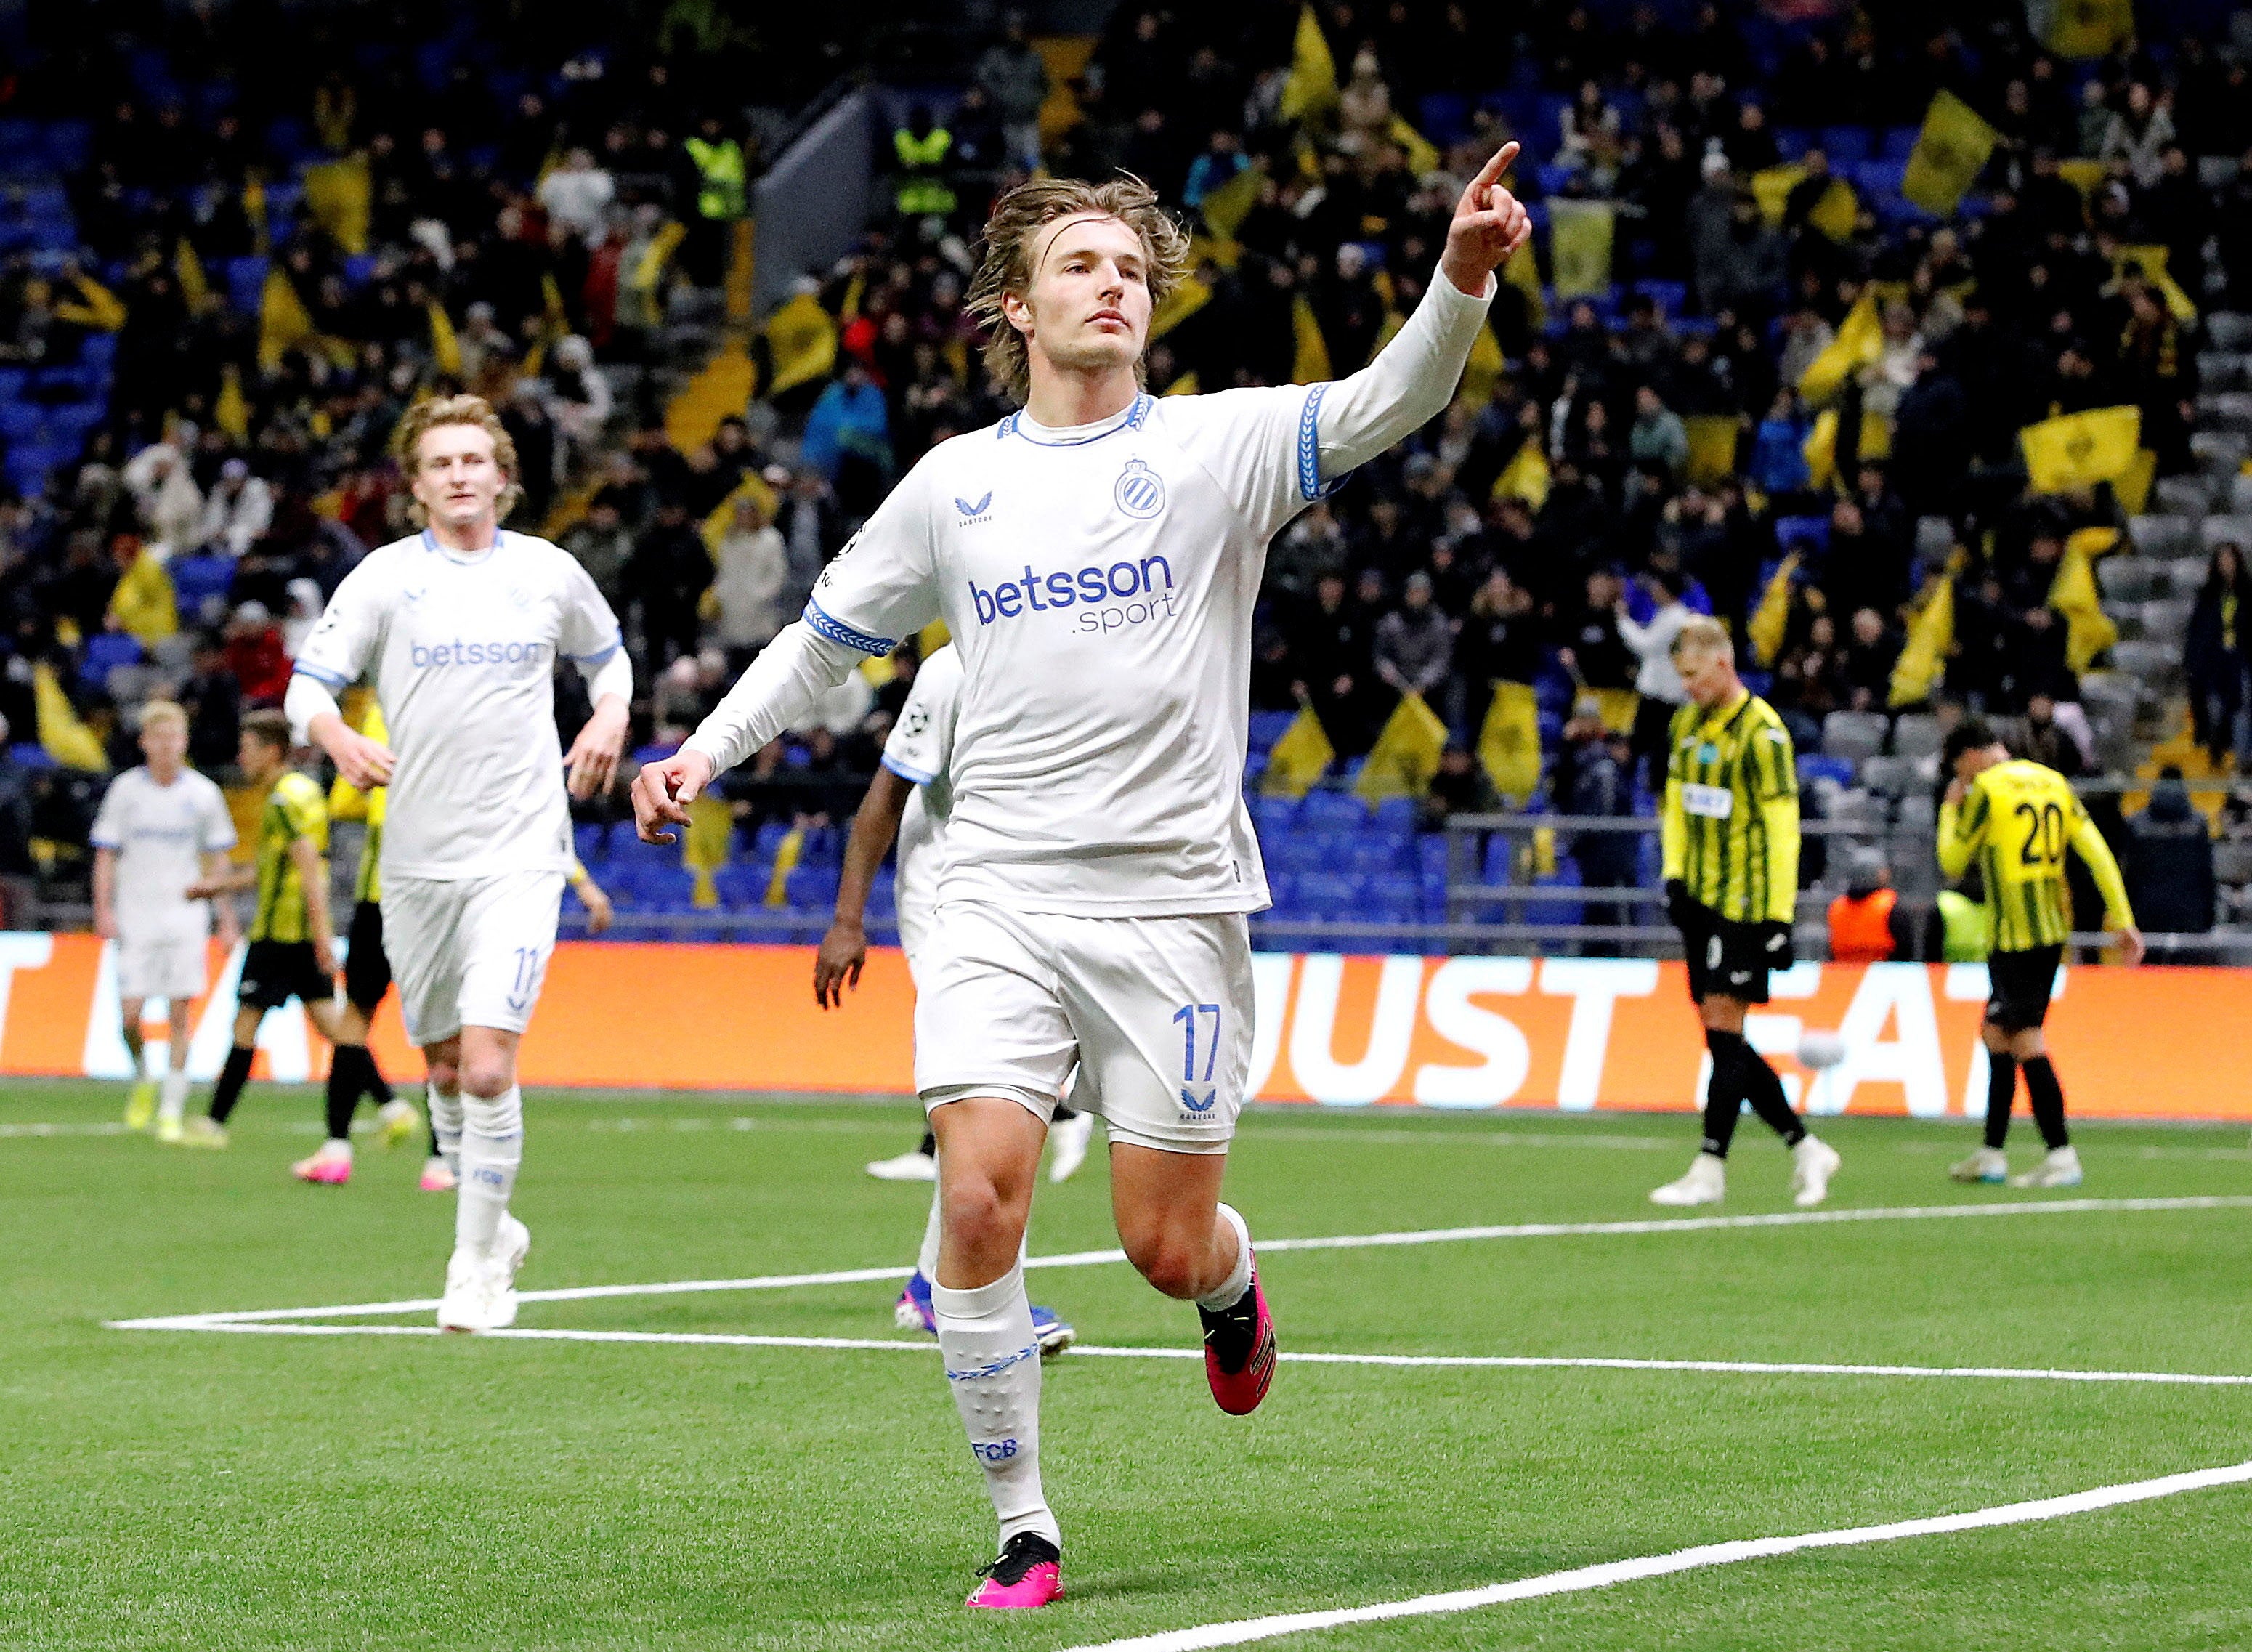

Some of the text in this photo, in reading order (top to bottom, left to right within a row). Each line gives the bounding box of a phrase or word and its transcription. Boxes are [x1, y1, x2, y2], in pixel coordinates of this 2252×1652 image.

[968, 555, 1172, 625] betsson
[1072, 593, 1177, 635] .sport
[411, 637, 540, 668] betsson
[2015, 803, 2062, 864] 20
[514, 947, 538, 993] 11
[1173, 1004, 1220, 1082] 17
[971, 1438, 1017, 1461] FCB
